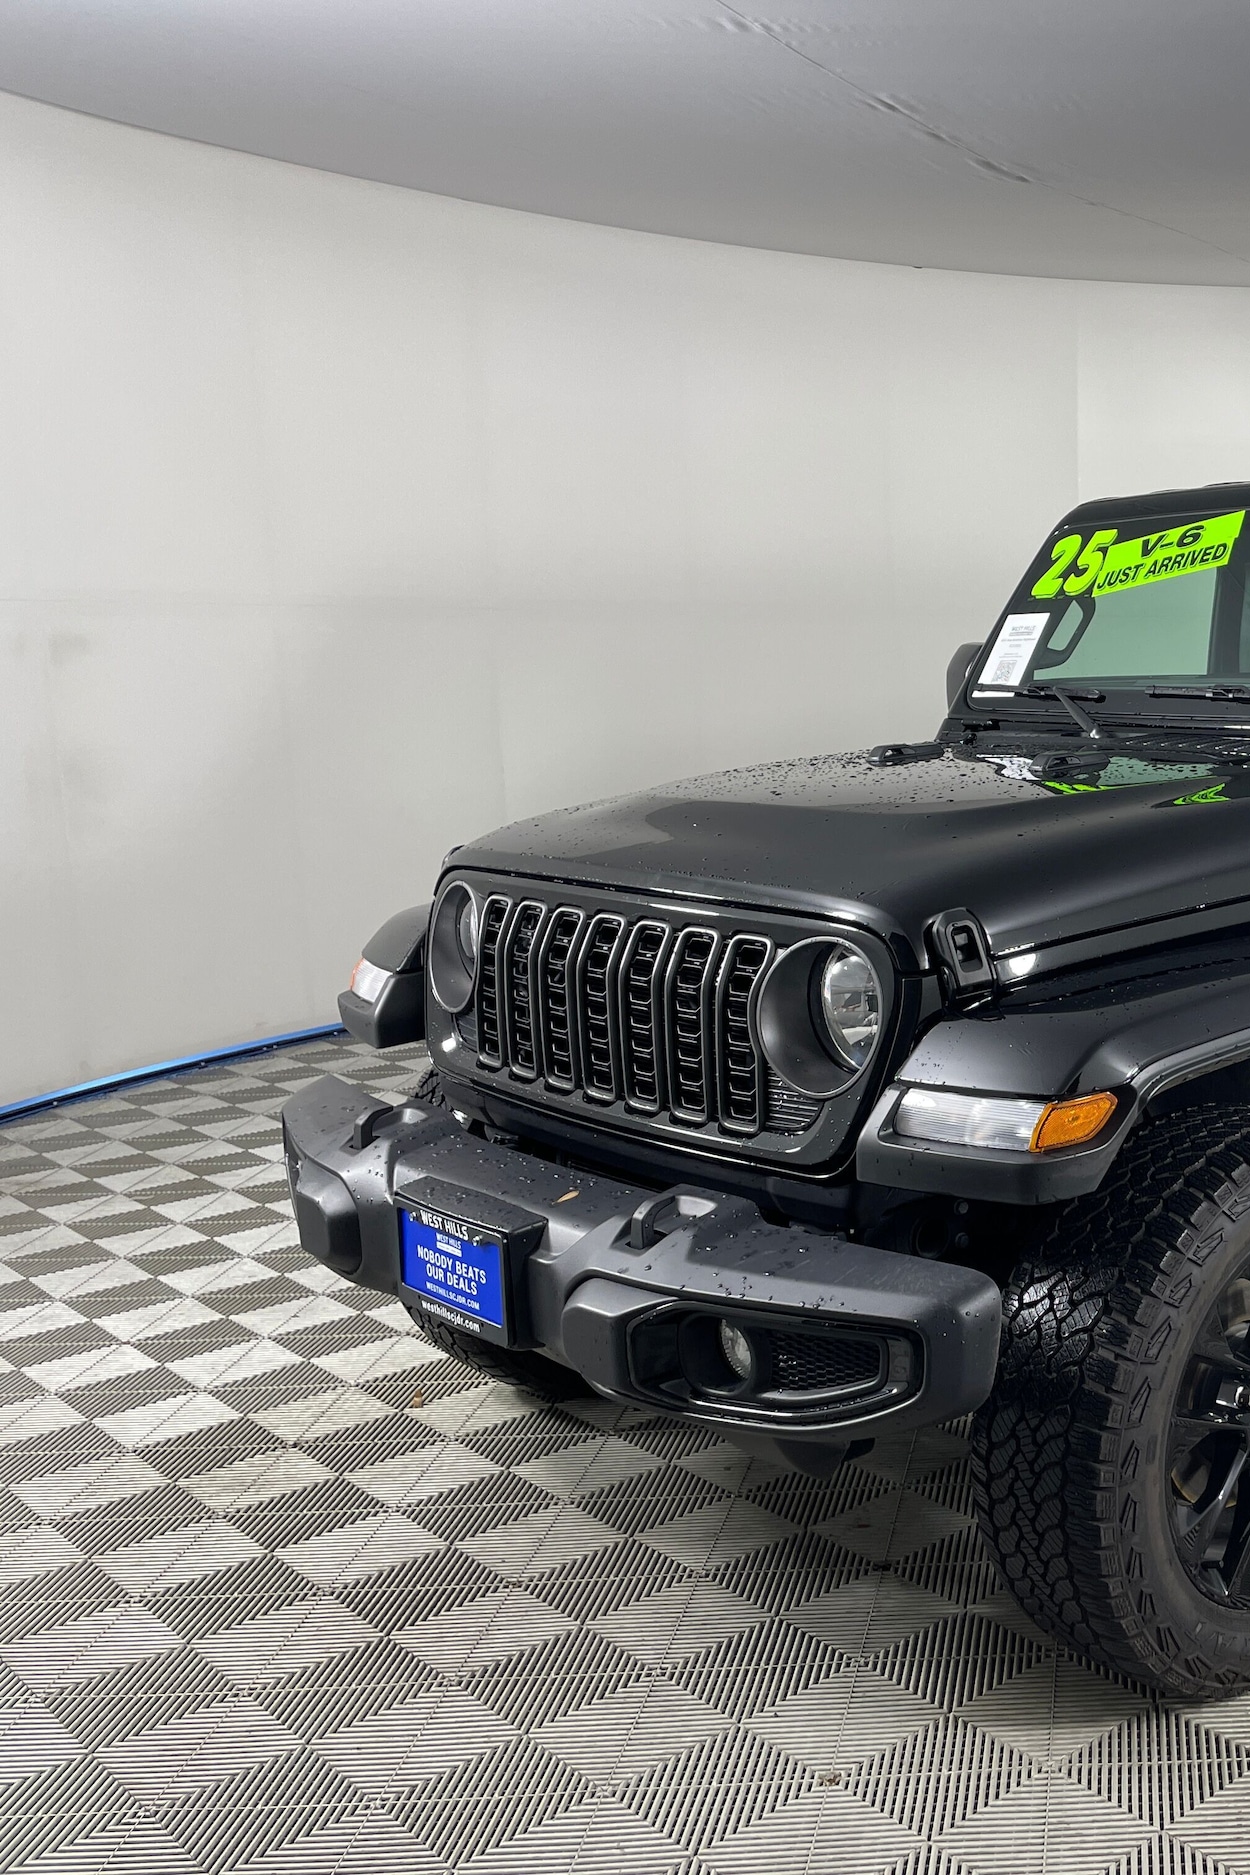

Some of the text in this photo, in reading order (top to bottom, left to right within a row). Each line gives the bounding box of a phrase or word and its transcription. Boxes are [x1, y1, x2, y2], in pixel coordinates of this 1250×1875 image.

[1141, 525, 1206, 558] V-6
[1031, 529, 1118, 598] 25
[1097, 543, 1228, 590] JUST ARRIVED
[420, 1210, 468, 1240] WEST HILLS
[436, 1233, 461, 1249] WEST HILLS
[417, 1245, 452, 1270] NOBODY
[455, 1262, 486, 1284] BEATS
[426, 1264, 477, 1295] OUR DEALS
[426, 1282, 480, 1310] WESTHILLSCJDR.COM
[422, 1300, 481, 1332] westhillscjdr.com
